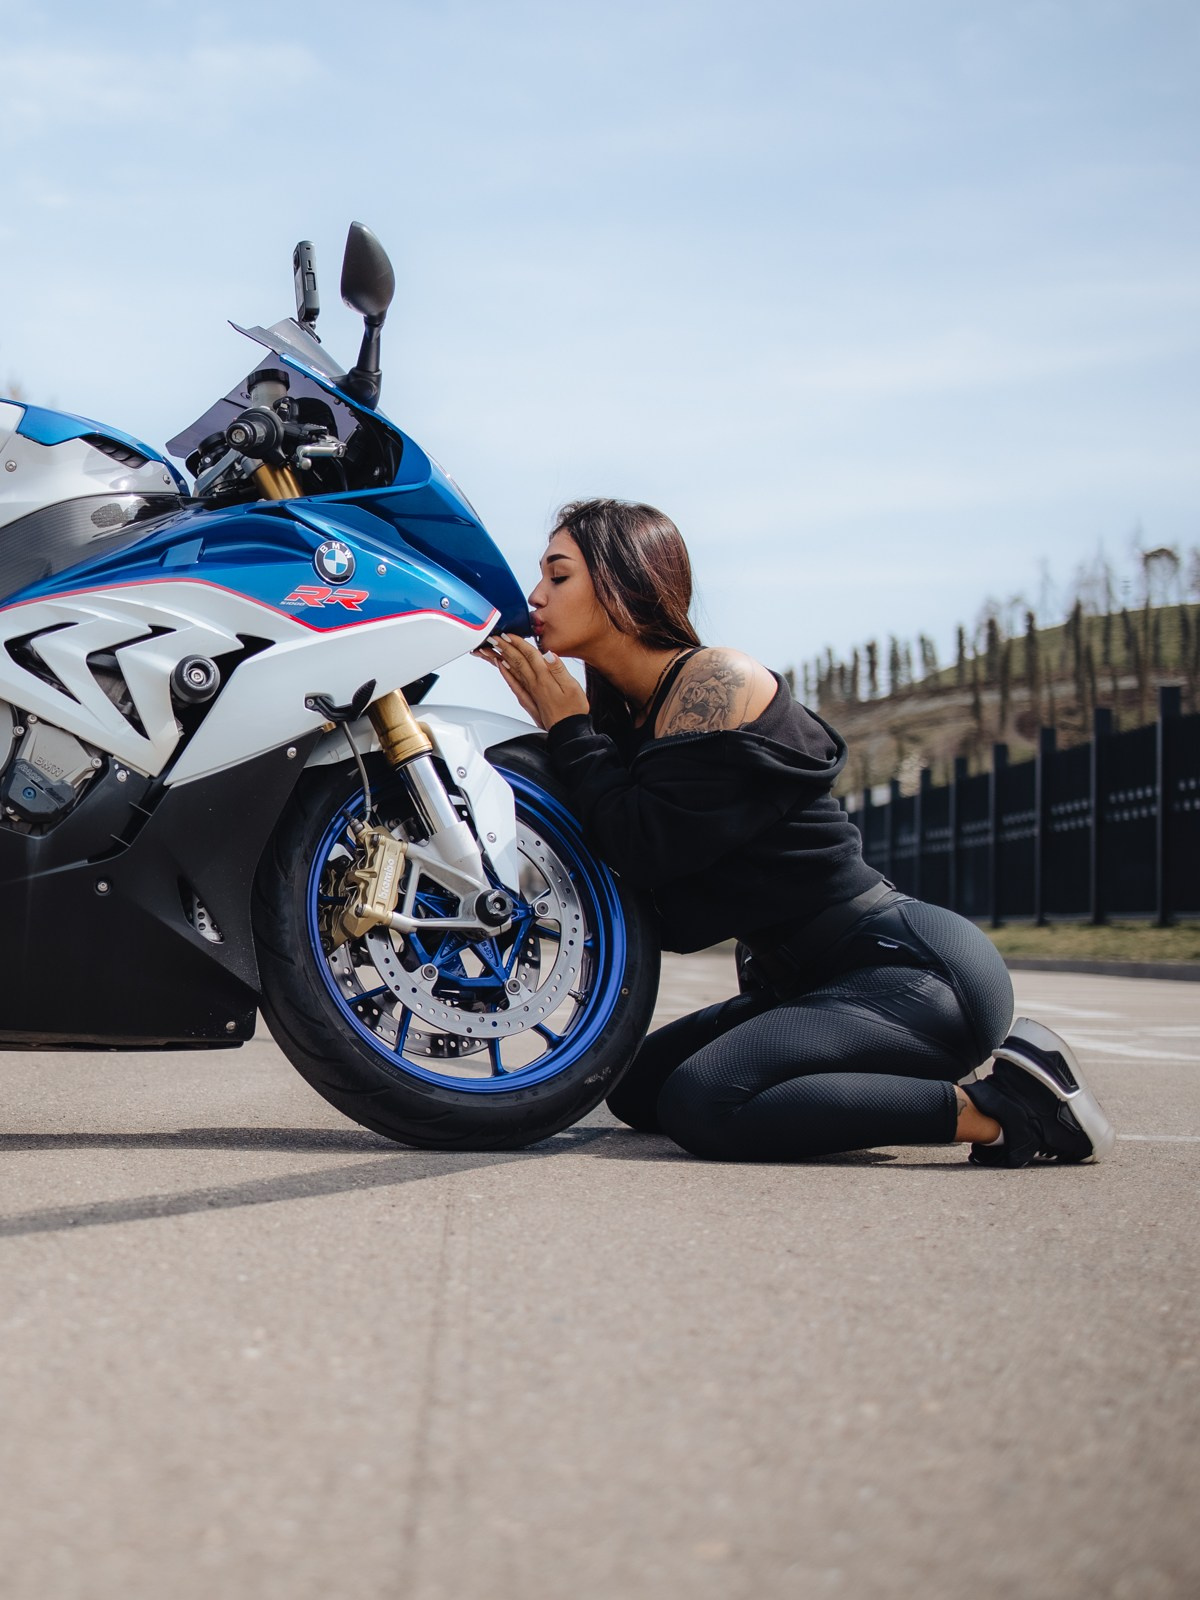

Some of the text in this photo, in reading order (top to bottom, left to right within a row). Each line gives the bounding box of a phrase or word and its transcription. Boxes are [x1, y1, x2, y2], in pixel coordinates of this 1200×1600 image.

[319, 541, 353, 559] BMW
[283, 585, 370, 611] RR
[34, 756, 64, 778] BMW
[377, 857, 395, 901] brembo
